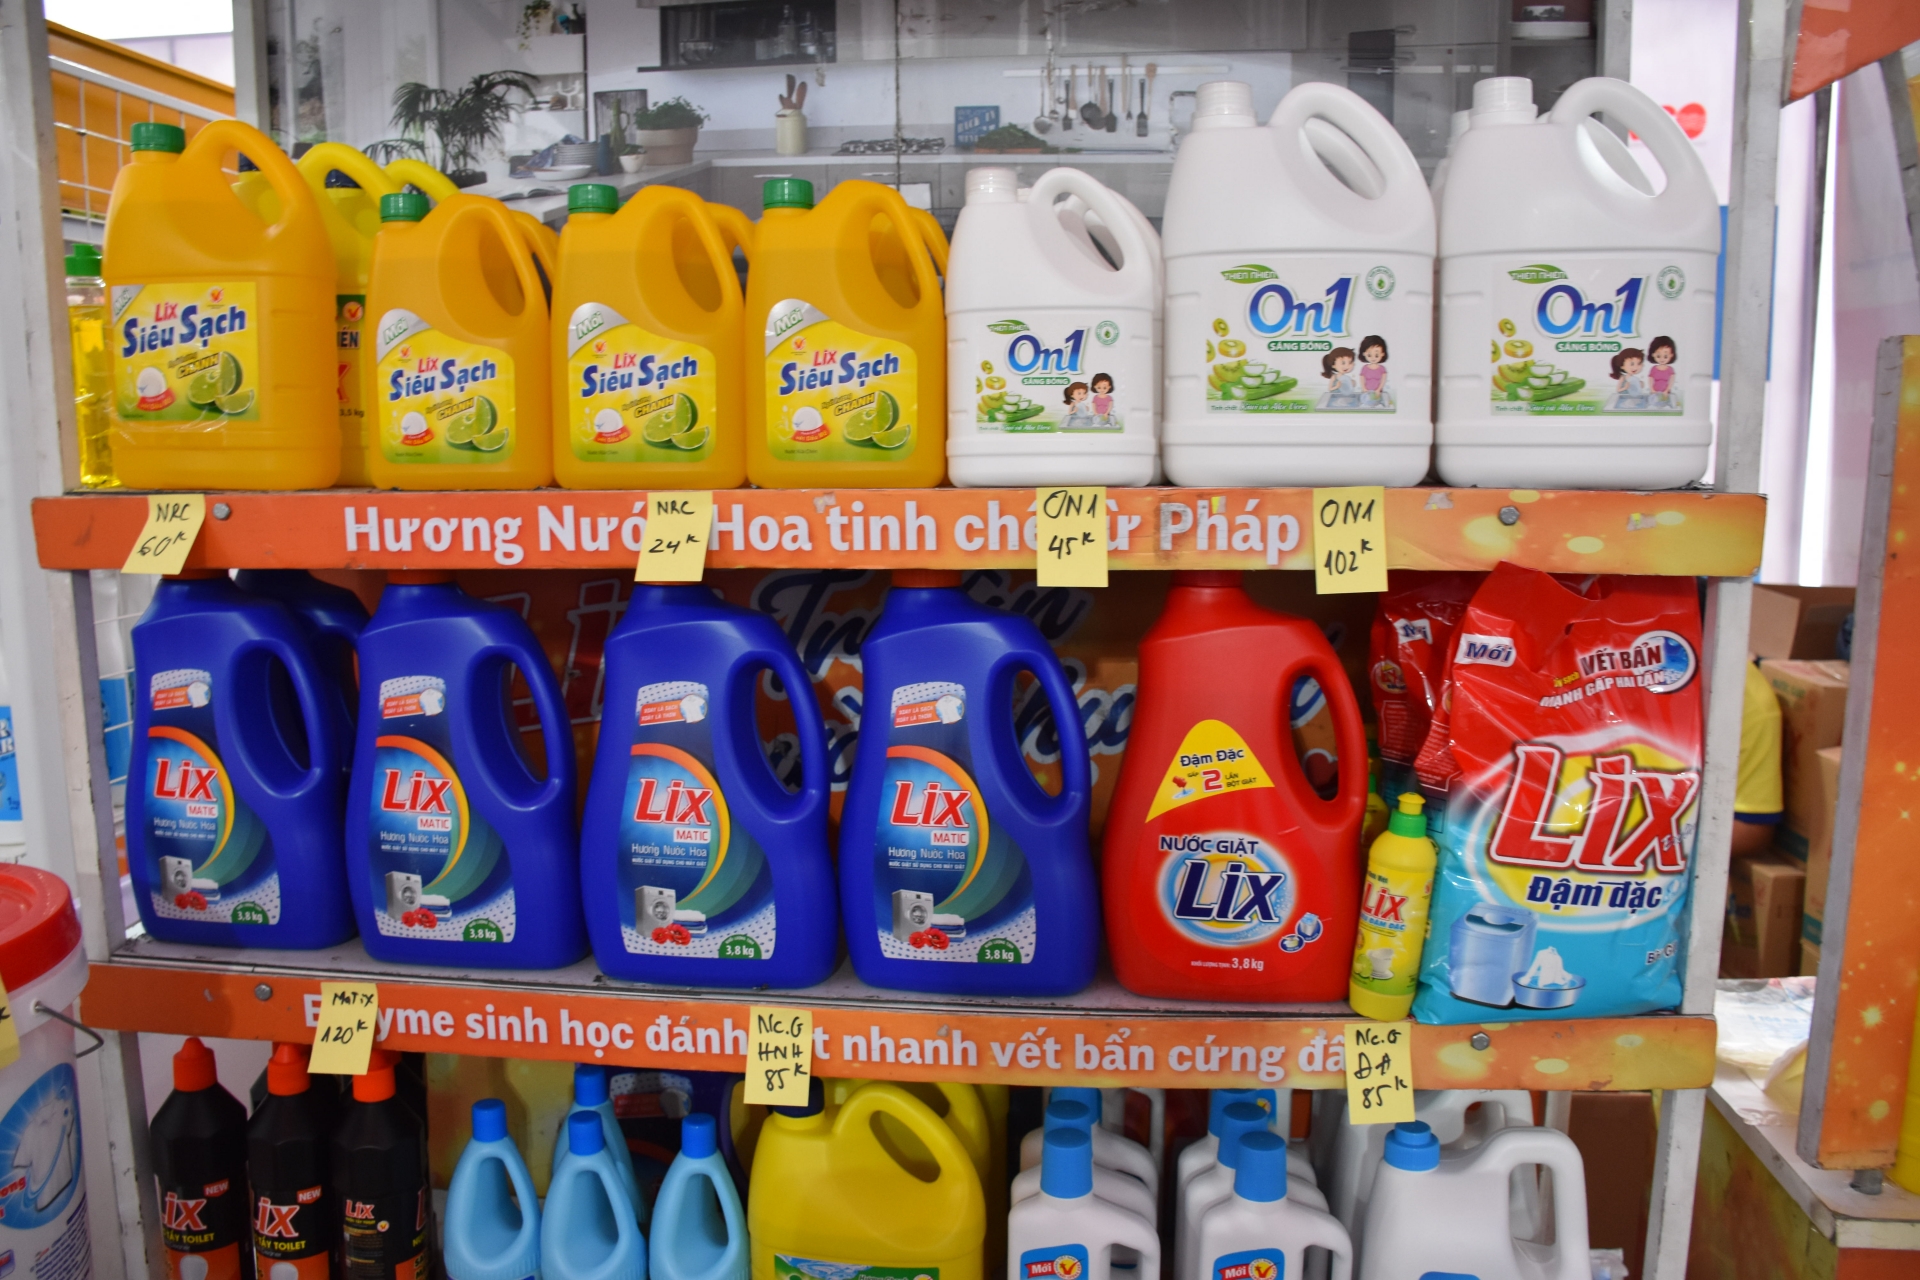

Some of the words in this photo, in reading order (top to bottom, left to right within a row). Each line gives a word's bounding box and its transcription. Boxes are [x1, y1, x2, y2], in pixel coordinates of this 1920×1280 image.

[155, 302, 178, 322] Lix
[1250, 277, 1352, 334] On1
[1537, 277, 1643, 334] On1
[122, 317, 175, 358] Siêu
[179, 305, 246, 348] Sạch
[576, 311, 604, 340] Mới
[774, 307, 804, 337] Mới
[1008, 329, 1085, 372] On1
[1270, 341, 1298, 351] SÁNG
[1300, 341, 1330, 351] BÓNG
[1558, 342, 1587, 352] SÁNG
[1589, 342, 1620, 352] BÓNG
[177, 352, 221, 379] CHANH
[418, 357, 439, 374] Lix
[614, 352, 637, 370] Lix
[813, 349, 838, 367] Lix
[389, 369, 435, 401] Siêu
[440, 359, 496, 393] Sạch
[581, 364, 633, 398] Siêu
[638, 355, 697, 390] Sạch
[779, 362, 833, 396] Siêu
[838, 352, 899, 387] Sạch
[437, 397, 474, 420] CHANH
[634, 395, 674, 418] CHANH
[834, 392, 875, 416] CHANH
[156, 503, 191, 522] NRC
[657, 500, 695, 515] NRC
[344, 506, 525, 566] Hương
[538, 500, 647, 553] Nướ
[707, 503, 813, 552] Hoa
[826, 500, 937, 552] tinh
[1159, 498, 1300, 565] Pháp
[1466, 641, 1513, 663] Mới
[1580, 646, 1616, 676] VẾT
[1620, 641, 1663, 669] BẨN
[1540, 687, 1584, 709] MẠNH
[1585, 676, 1614, 697] GẤP
[1616, 676, 1636, 689] HAI
[1180, 754, 1213, 768] Đậm
[1216, 749, 1244, 762] Đặc
[153, 757, 219, 802] Lix
[381, 767, 453, 814] Lix
[1202, 768, 1224, 792] 2
[188, 805, 217, 817] MATIC
[634, 776, 713, 826] Lix
[890, 780, 971, 828] Lix
[1488, 743, 1700, 874] Lix
[420, 818, 449, 830] MATIC
[676, 830, 708, 841] MATIC
[933, 832, 967, 844] MATIC
[1159, 835, 1212, 853] NƯỚC
[1216, 840, 1259, 857] GIẶT
[947, 849, 966, 860] Hoa
[1173, 858, 1286, 924] Lix
[1527, 875, 1604, 909] Đậm
[1602, 879, 1663, 911] đặc
[1362, 882, 1408, 923] Lix
[237, 910, 251, 923] 3,8
[251, 911, 263, 925] kg
[469, 927, 485, 939] 3,8
[485, 927, 497, 940] kg
[725, 944, 741, 957] 3,8
[741, 945, 755, 959] kg
[985, 949, 1001, 961] 3,8
[1001, 949, 1014, 964] kg
[1250, 958, 1264, 972] kg
[303, 993, 455, 1042] Eyme
[466, 1004, 549, 1041] sinh
[561, 1008, 634, 1058] học
[646, 1013, 747, 1056] đánh
[843, 1025, 978, 1068] nhanh
[989, 1026, 1061, 1071] vết
[1075, 1027, 1155, 1073] bẩn
[1168, 1034, 1286, 1082] cứng
[205, 1180, 229, 1196] NEW
[299, 1188, 322, 1202] NEW
[161, 1191, 207, 1231] ix
[254, 1196, 300, 1238] ix
[346, 1199, 375, 1219] Lix
[182, 1232, 215, 1245] TOILET
[273, 1239, 306, 1251] TOILET
[1031, 1262, 1052, 1275] Mới
[1225, 1266, 1247, 1279] Mới
